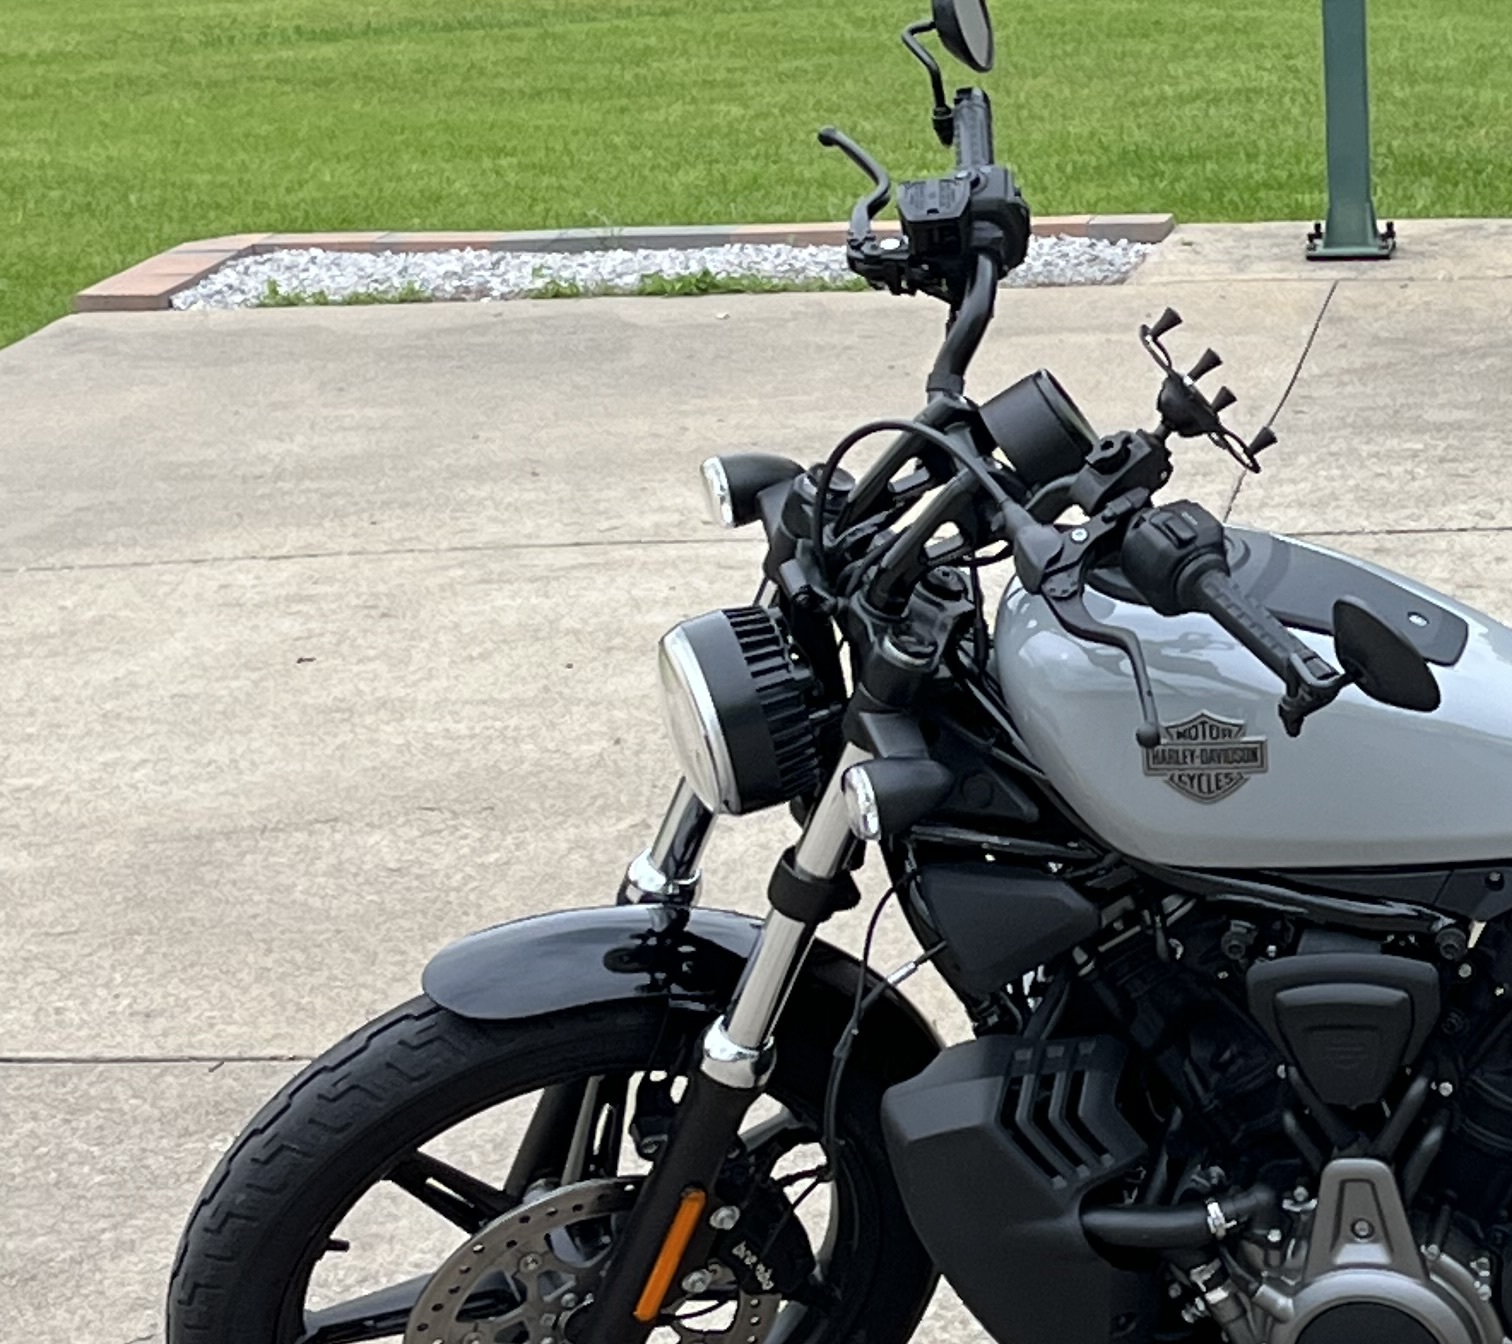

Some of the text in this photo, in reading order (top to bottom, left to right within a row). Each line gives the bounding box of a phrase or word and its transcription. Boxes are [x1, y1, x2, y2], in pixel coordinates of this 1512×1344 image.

[1176, 720, 1233, 741] MOTOR
[1152, 746, 1259, 765] HARLEY-DAVIDSON
[1177, 772, 1234, 795] CYCLES
